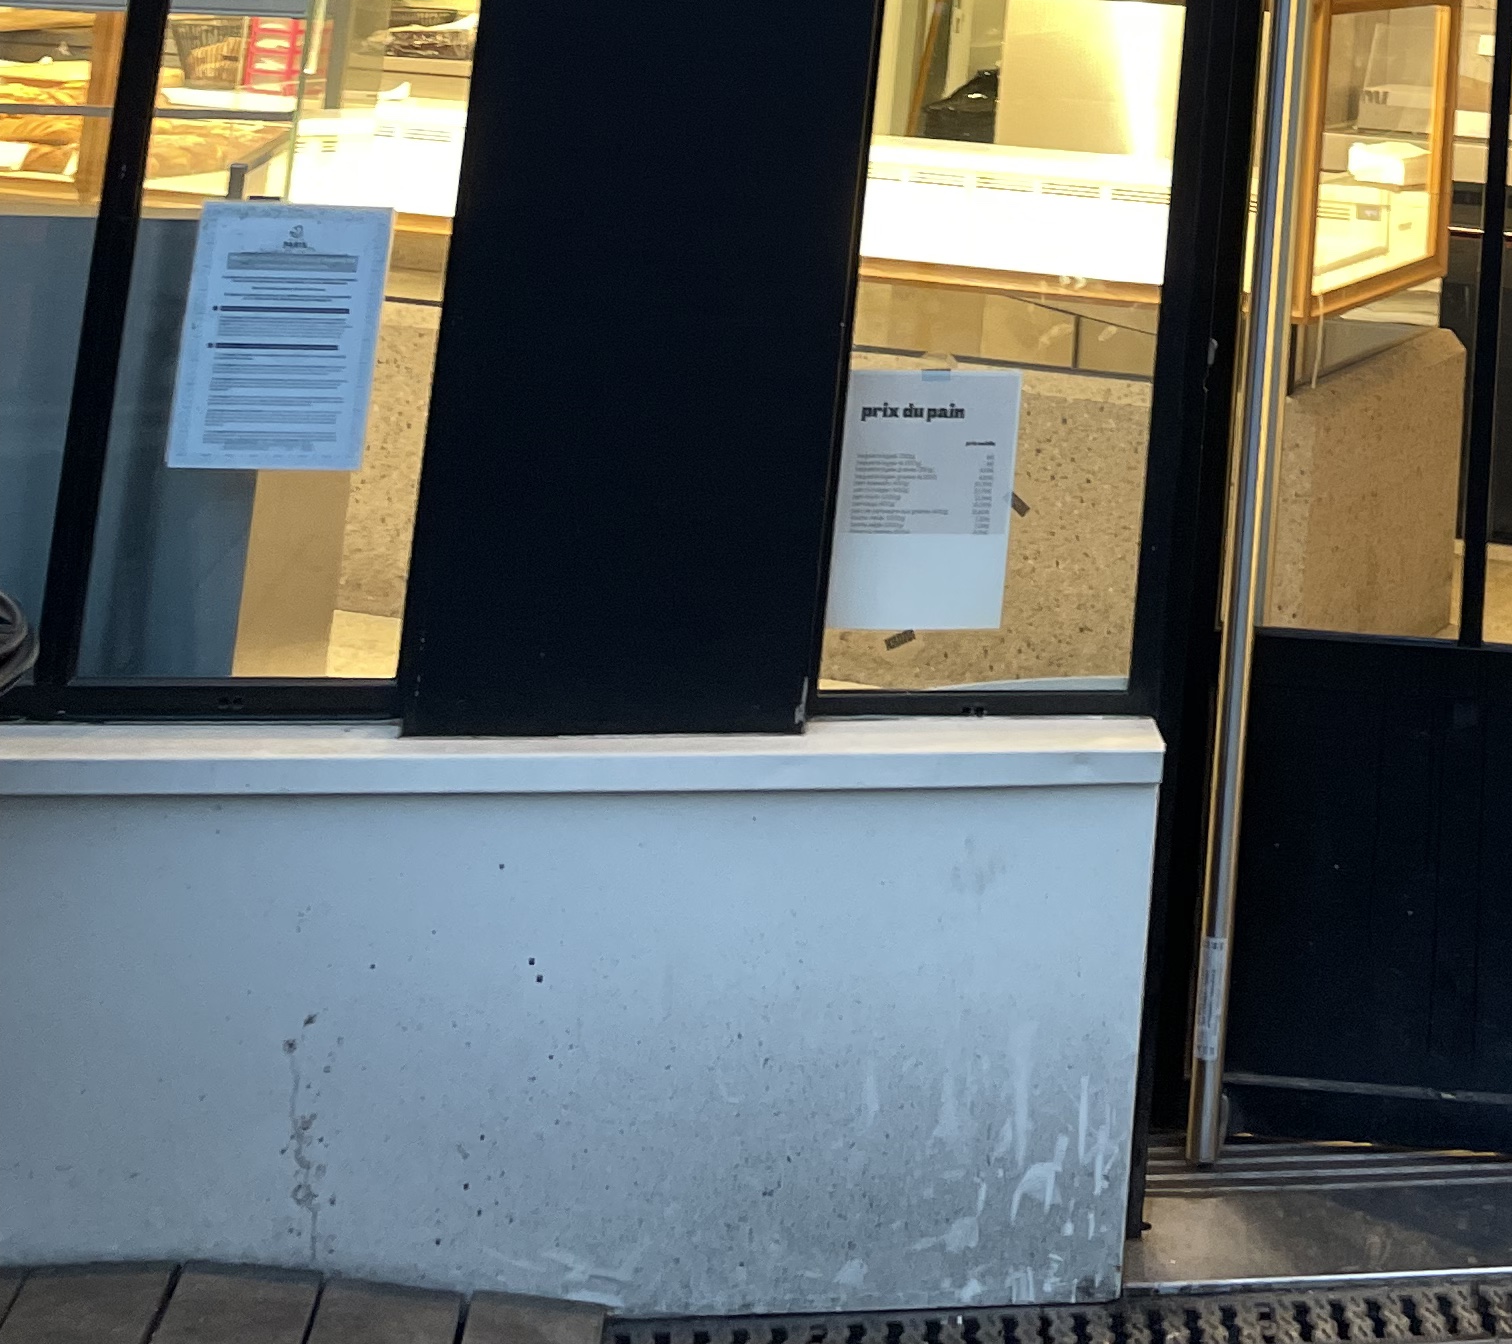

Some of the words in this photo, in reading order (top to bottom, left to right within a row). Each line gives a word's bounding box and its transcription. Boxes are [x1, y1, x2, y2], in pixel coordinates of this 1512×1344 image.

[860, 402, 899, 422] prix
[902, 403, 924, 419] du
[926, 403, 966, 422] pain
